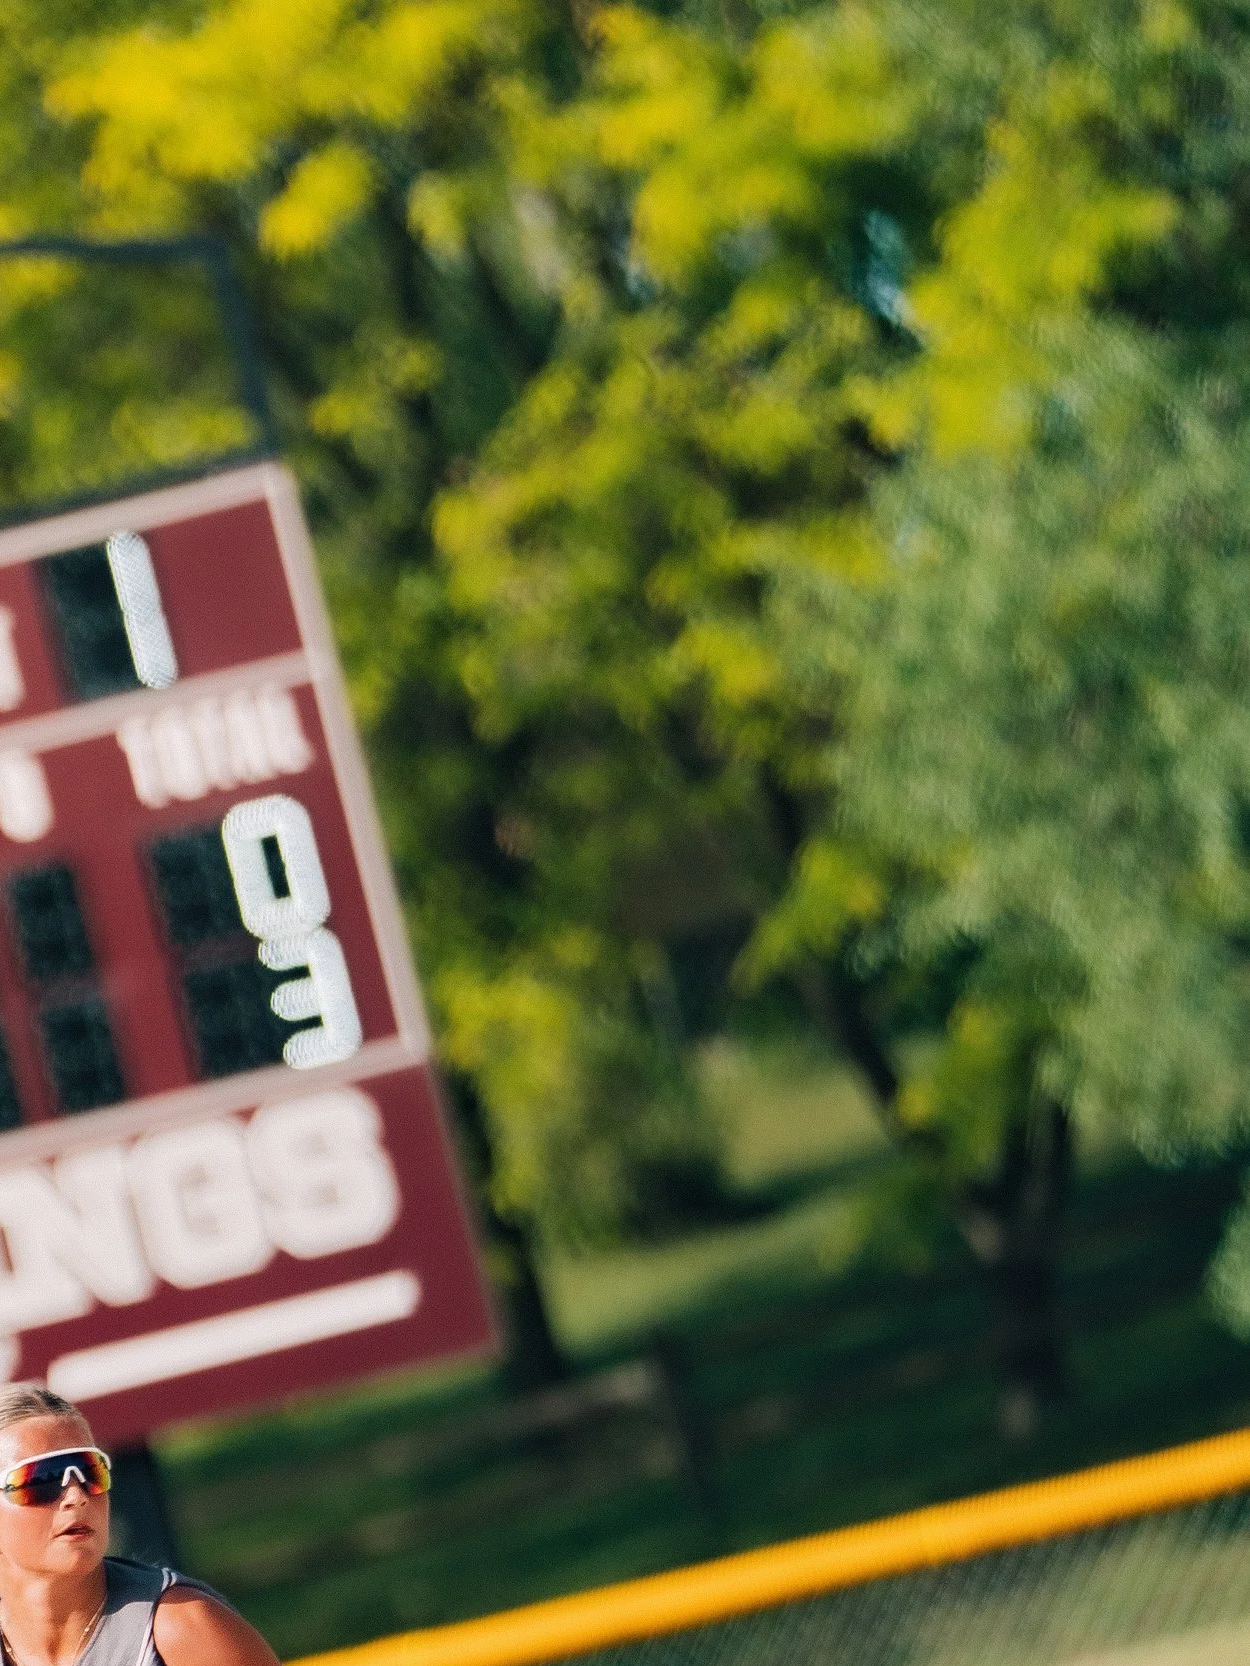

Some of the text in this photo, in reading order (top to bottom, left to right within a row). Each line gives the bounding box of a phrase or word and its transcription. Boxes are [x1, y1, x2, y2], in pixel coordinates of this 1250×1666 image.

[106, 530, 178, 690] 1
[117, 683, 314, 808] TOTAL
[222, 795, 330, 937] 0
[258, 927, 362, 1070] 3
